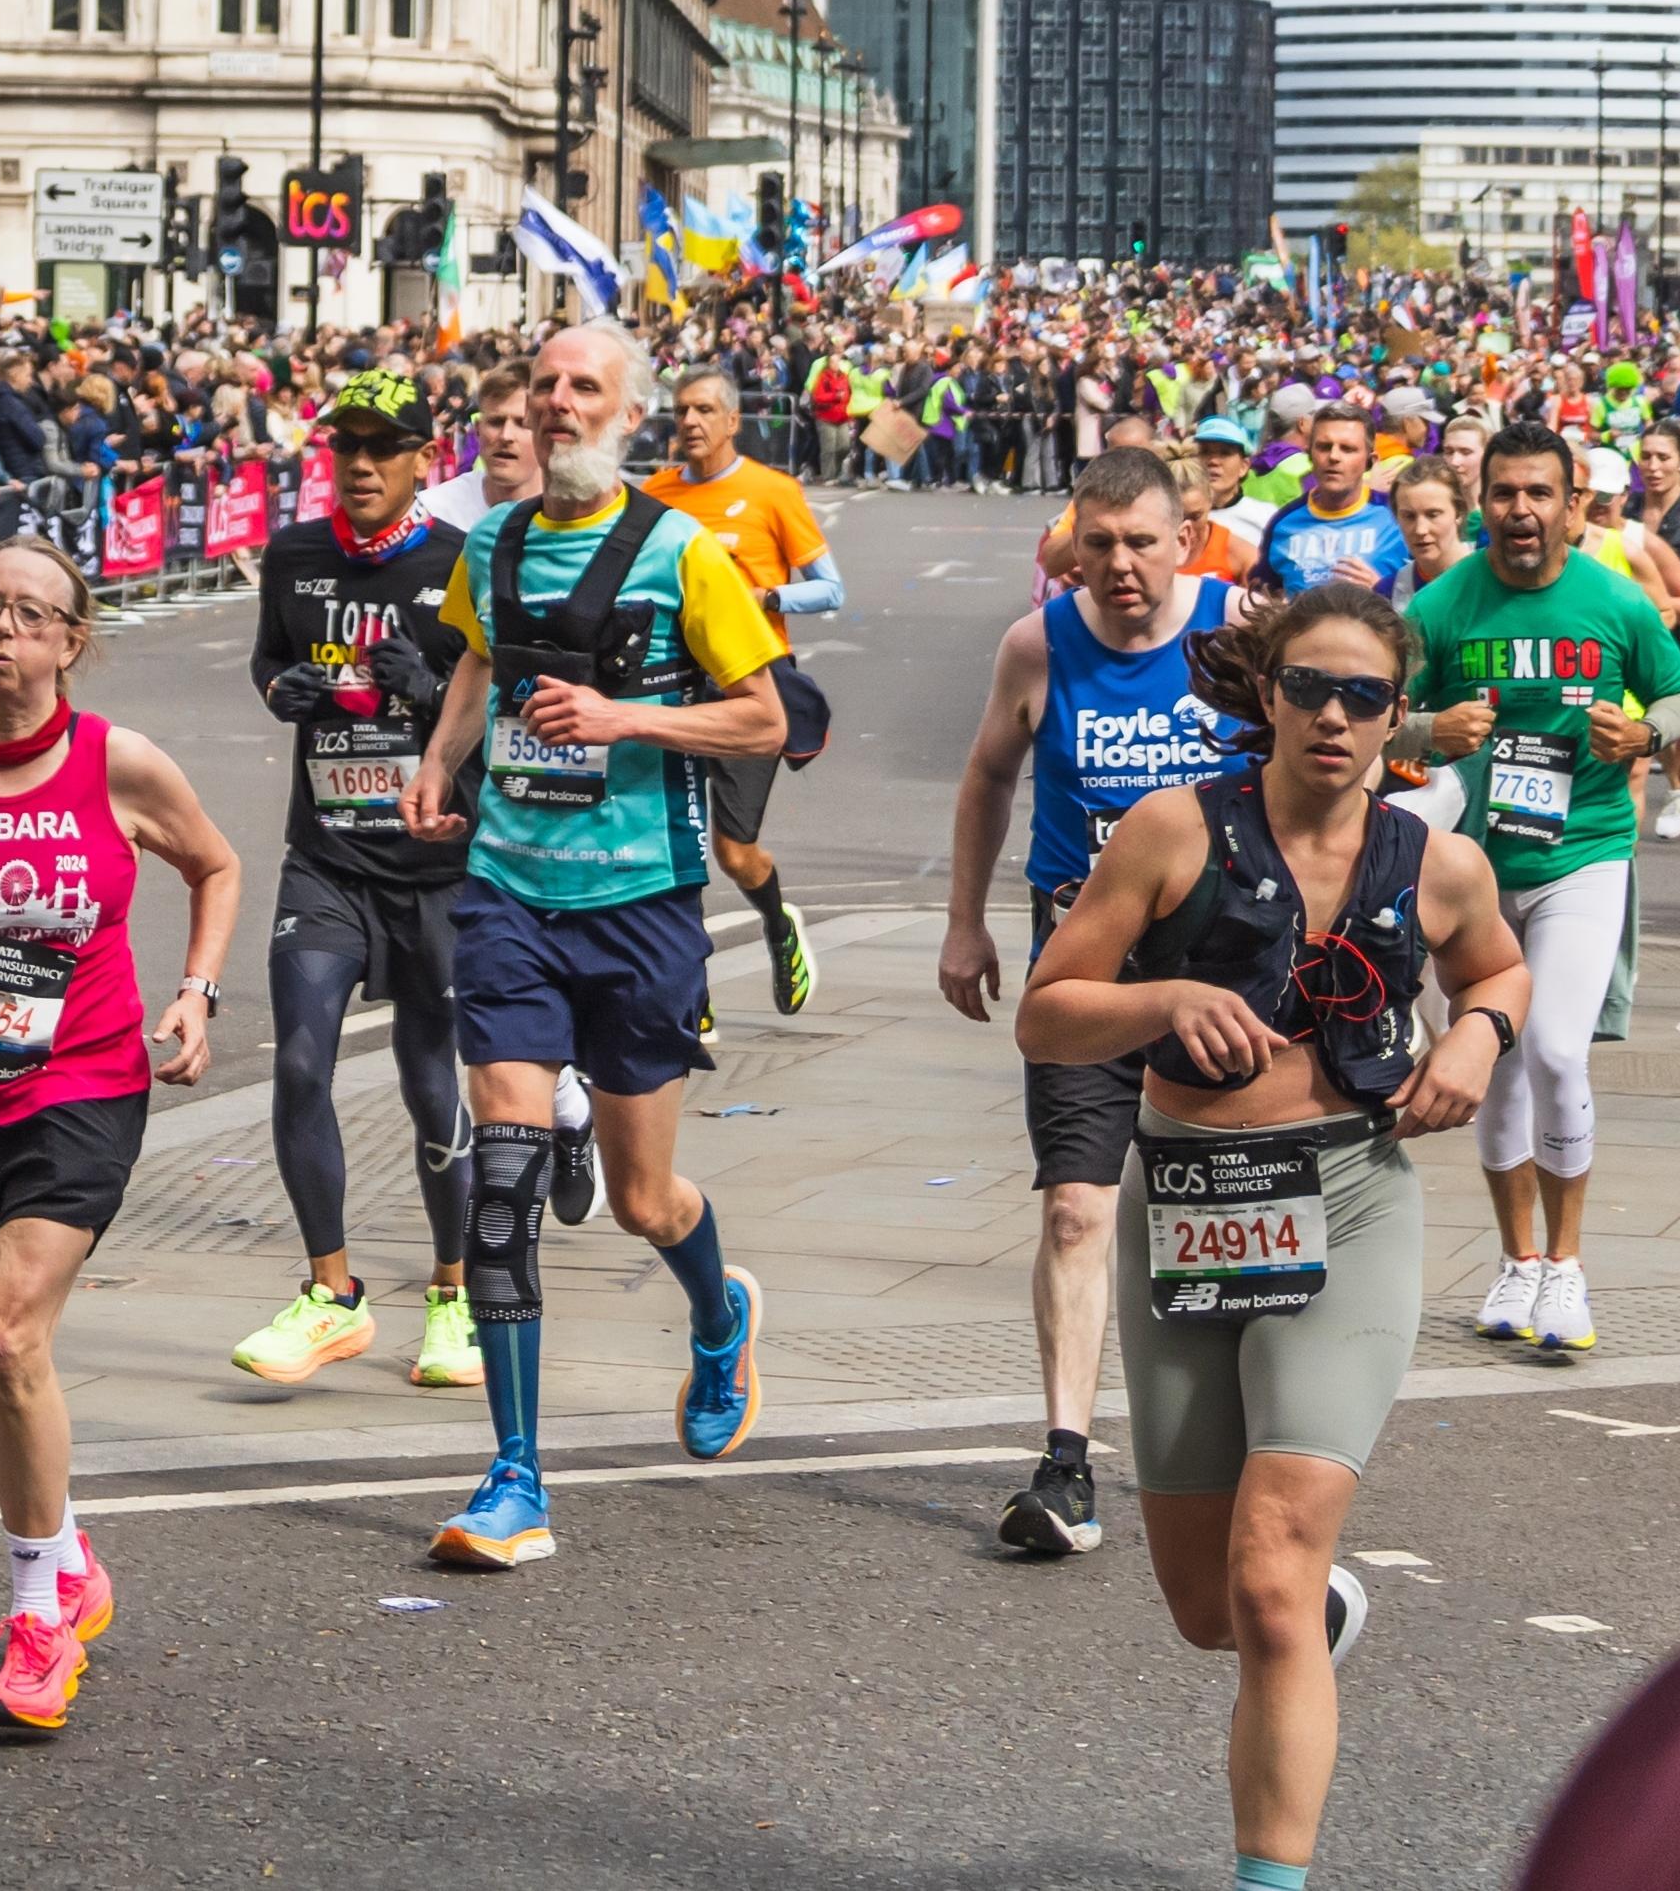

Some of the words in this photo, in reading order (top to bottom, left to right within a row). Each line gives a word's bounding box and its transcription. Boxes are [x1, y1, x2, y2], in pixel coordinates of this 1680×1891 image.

[82, 177, 155, 195] Trafalgar
[90, 196, 148, 211] Square
[288, 178, 352, 239] tcs
[45, 221, 114, 236] Lambeth
[1289, 528, 1377, 562] DAVID
[324, 599, 401, 646] TOTO
[1459, 636, 1603, 680] MEXICO
[642, 672, 679, 686] ELEVATE
[1076, 707, 1171, 746] Foyle
[351, 733, 413, 743] CONSULTANCY
[352, 742, 390, 751] SERVICES
[1076, 735, 1222, 774] Hospice
[1515, 744, 1571, 760] CONSULTANCY
[327, 765, 404, 795] 16084
[502, 776, 531, 798] NB
[1080, 774, 1157, 789] TOGETHER
[1159, 774, 1183, 786] WE
[527, 789, 548, 802] new
[549, 788, 593, 804] balance
[683, 752, 705, 831] ancer
[357, 818, 375, 828] new
[1518, 823, 1554, 839] balance
[55, 854, 89, 872] 2024
[1208, 1153, 1250, 1166] TATA
[1211, 1160, 1304, 1181] CONSULTANCY
[1213, 1178, 1273, 1195] SERVICES
[1173, 1213, 1301, 1263] 24914
[1167, 1282, 1221, 1312] NB
[1221, 1297, 1252, 1311] new
[1253, 1293, 1309, 1308] balance
